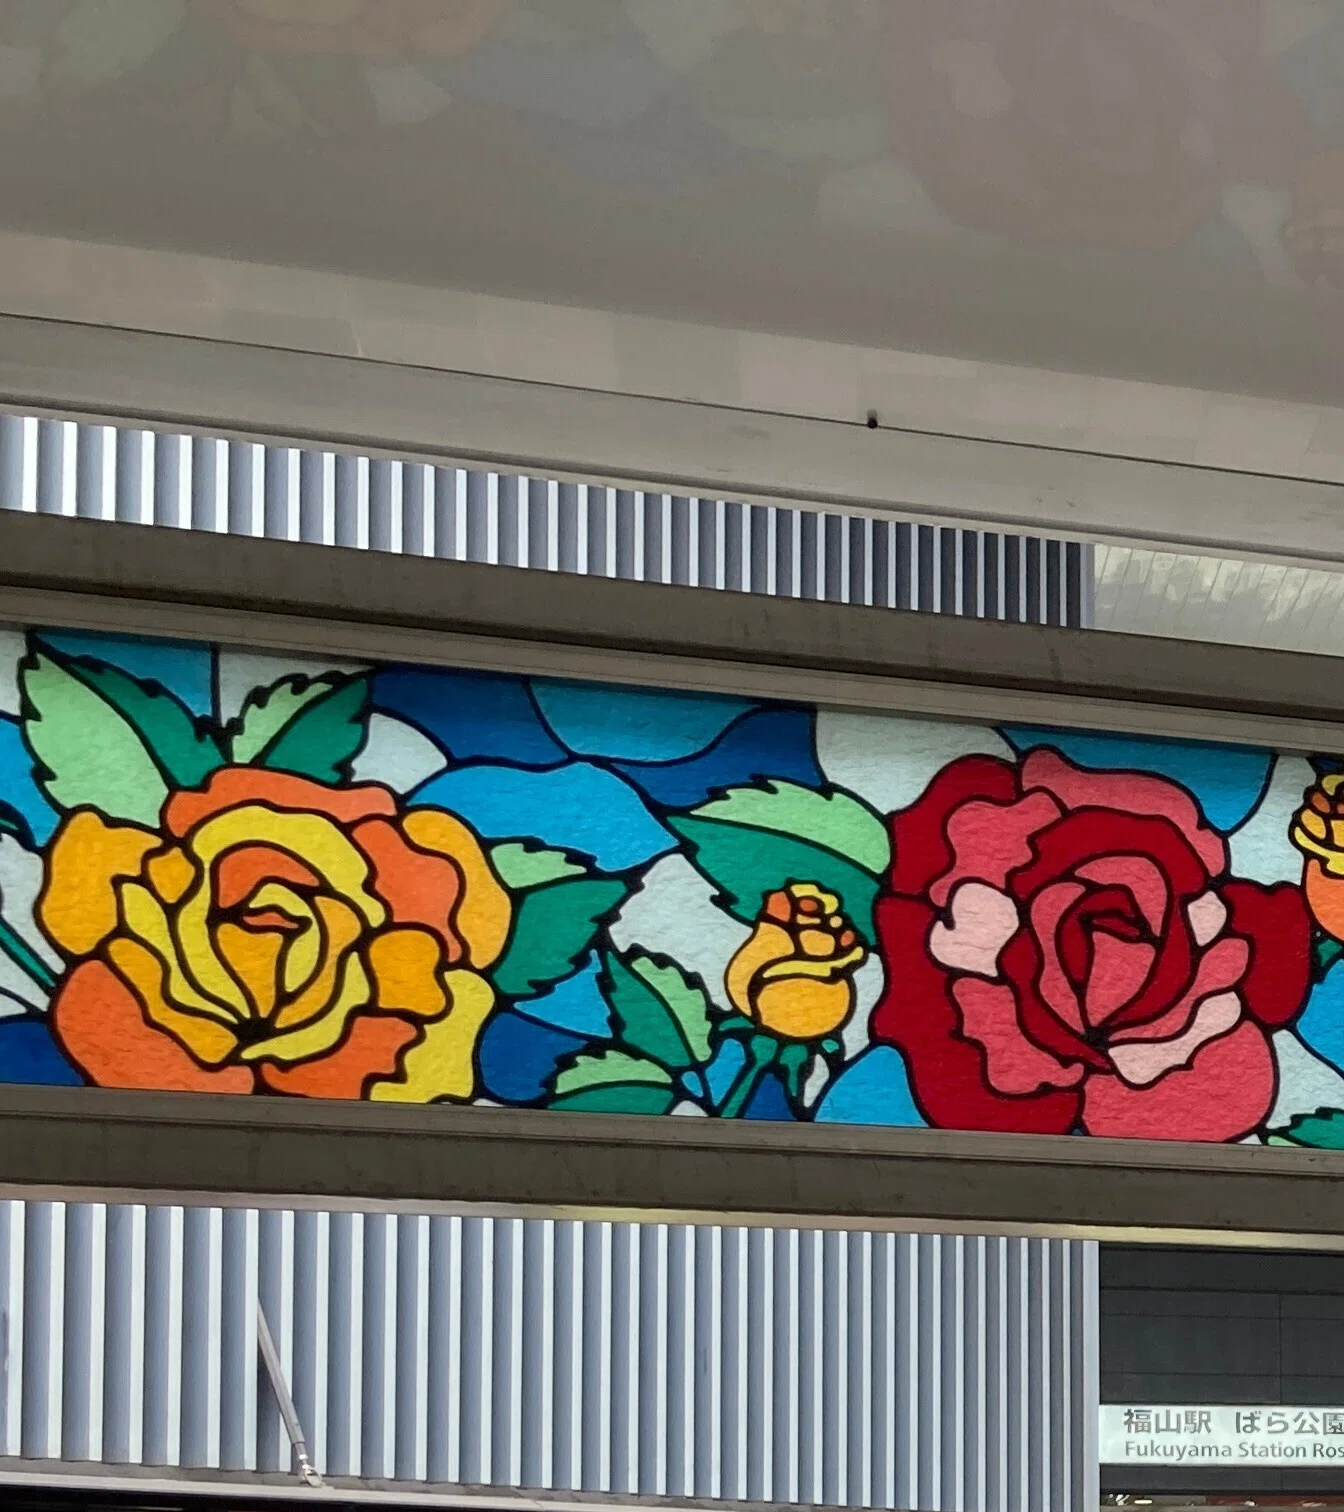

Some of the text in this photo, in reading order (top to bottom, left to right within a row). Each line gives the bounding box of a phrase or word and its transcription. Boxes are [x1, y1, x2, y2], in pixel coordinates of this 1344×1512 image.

[1124, 1408, 1212, 1434] 福山駅
[1125, 1440, 1232, 1462] Fukuyama
[1239, 1441, 1307, 1458] Station
